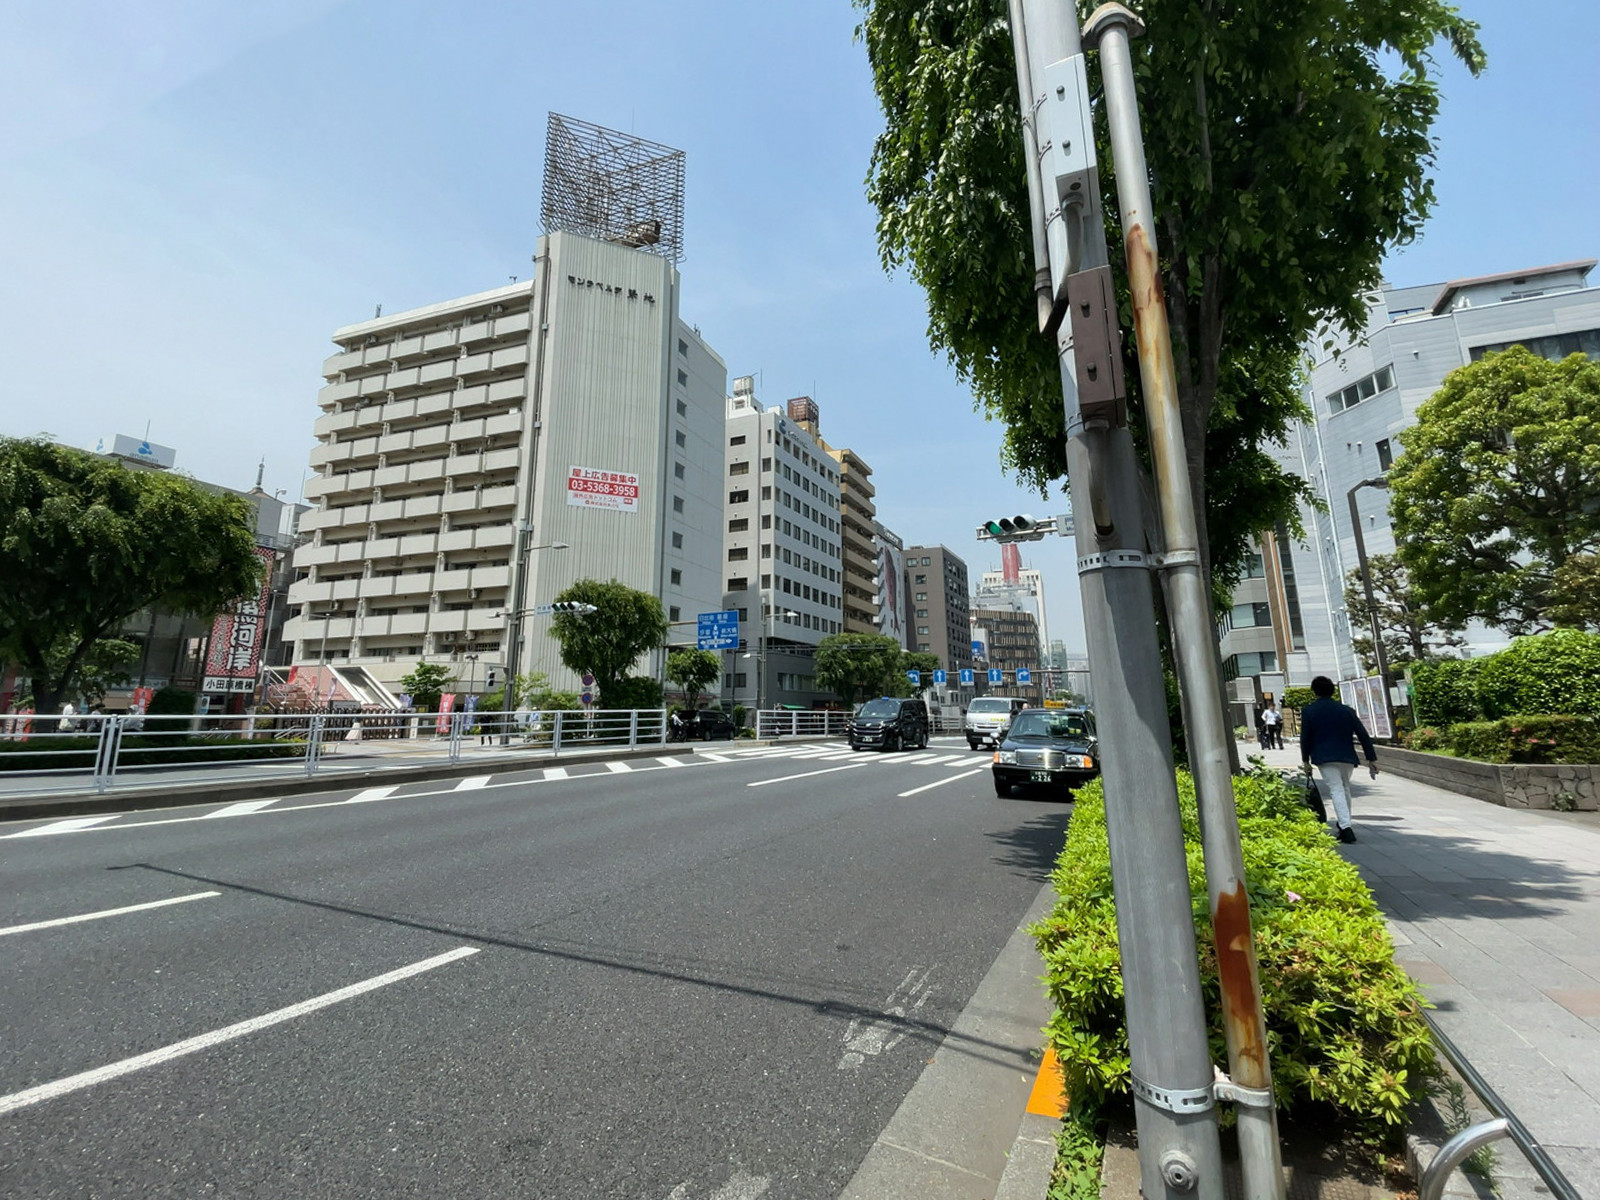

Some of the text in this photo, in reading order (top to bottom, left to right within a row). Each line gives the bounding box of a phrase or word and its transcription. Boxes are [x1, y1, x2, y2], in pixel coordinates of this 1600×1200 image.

[573, 468, 636, 484] 屋上広告募集中
[571, 480, 635, 496] 03-5368-3958
